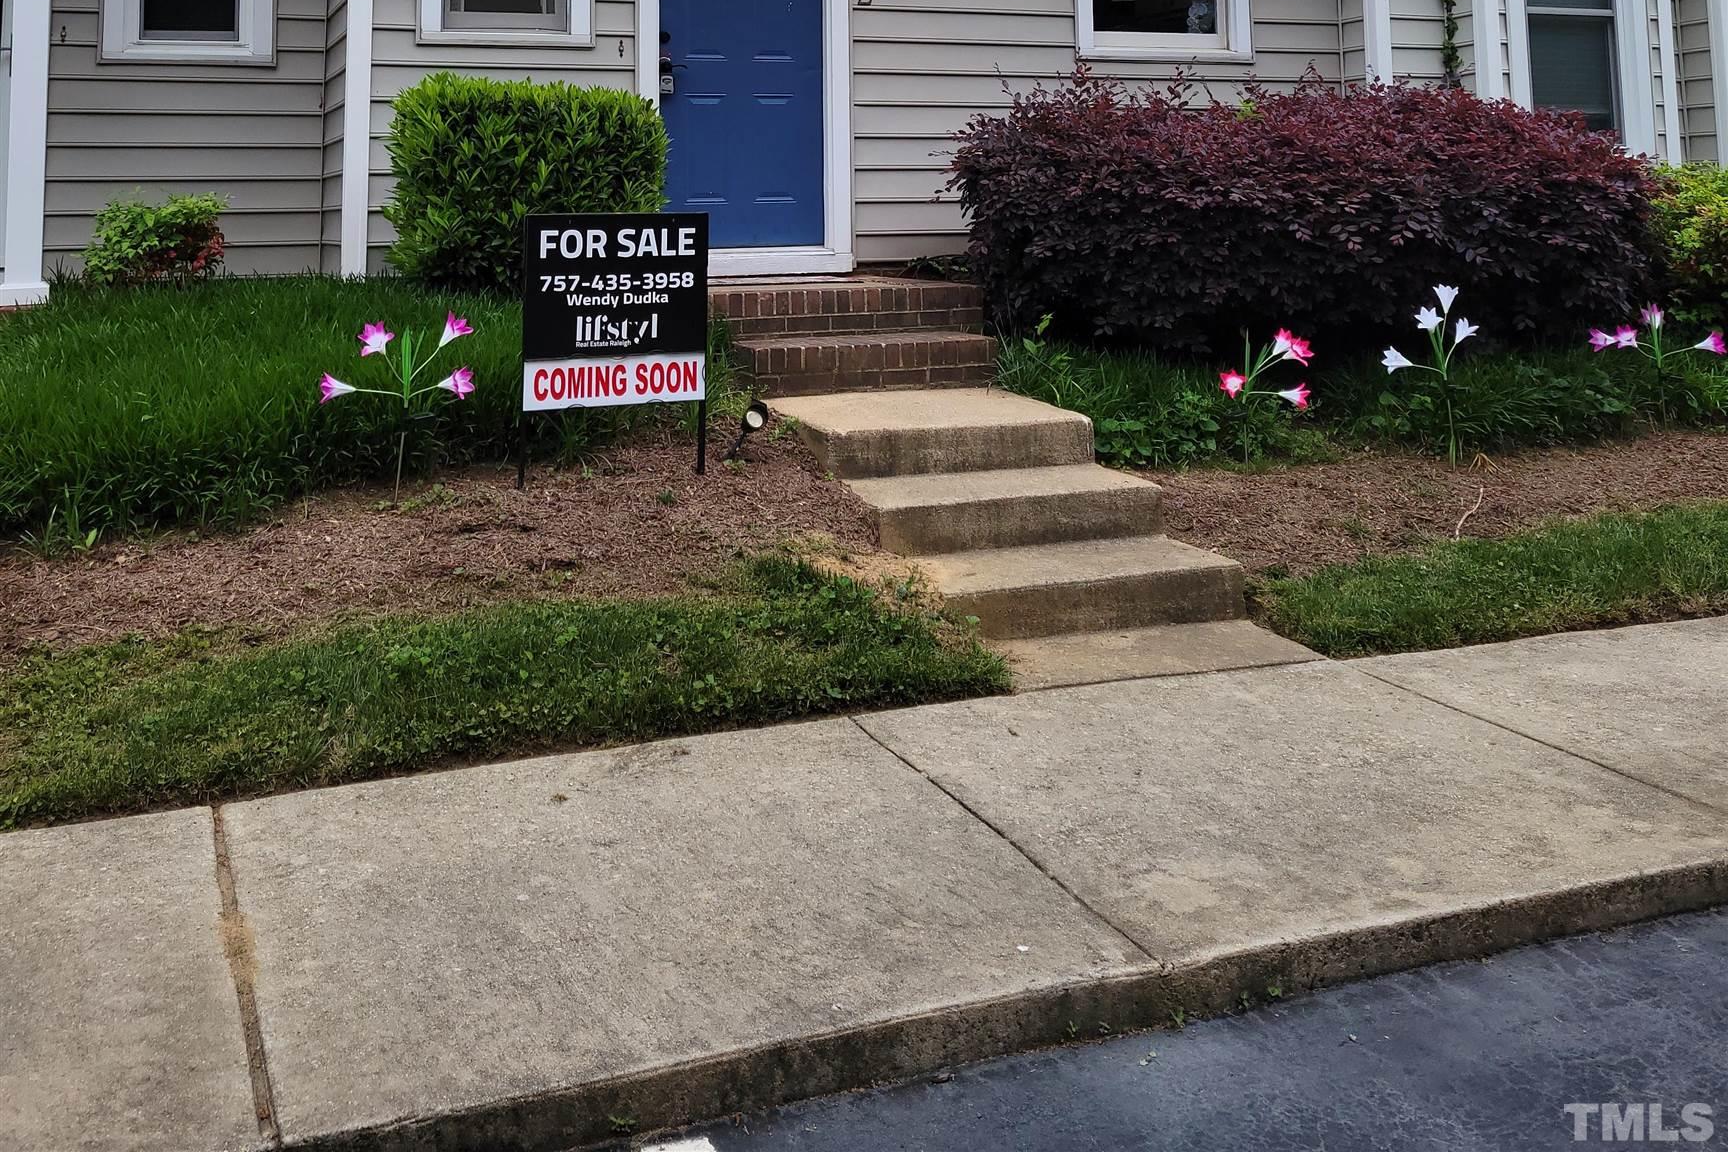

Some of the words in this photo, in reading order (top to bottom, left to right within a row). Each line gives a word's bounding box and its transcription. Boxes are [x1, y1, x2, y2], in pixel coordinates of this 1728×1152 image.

[540, 230, 607, 259] FOR
[617, 227, 696, 257] SALE
[540, 272, 694, 292] 757-435-3958
[566, 293, 619, 308] Wendy
[623, 292, 669, 305] Dudka
[610, 339, 632, 347] Raleigh
[534, 365, 627, 402] COMING
[635, 360, 698, 395] SOON
